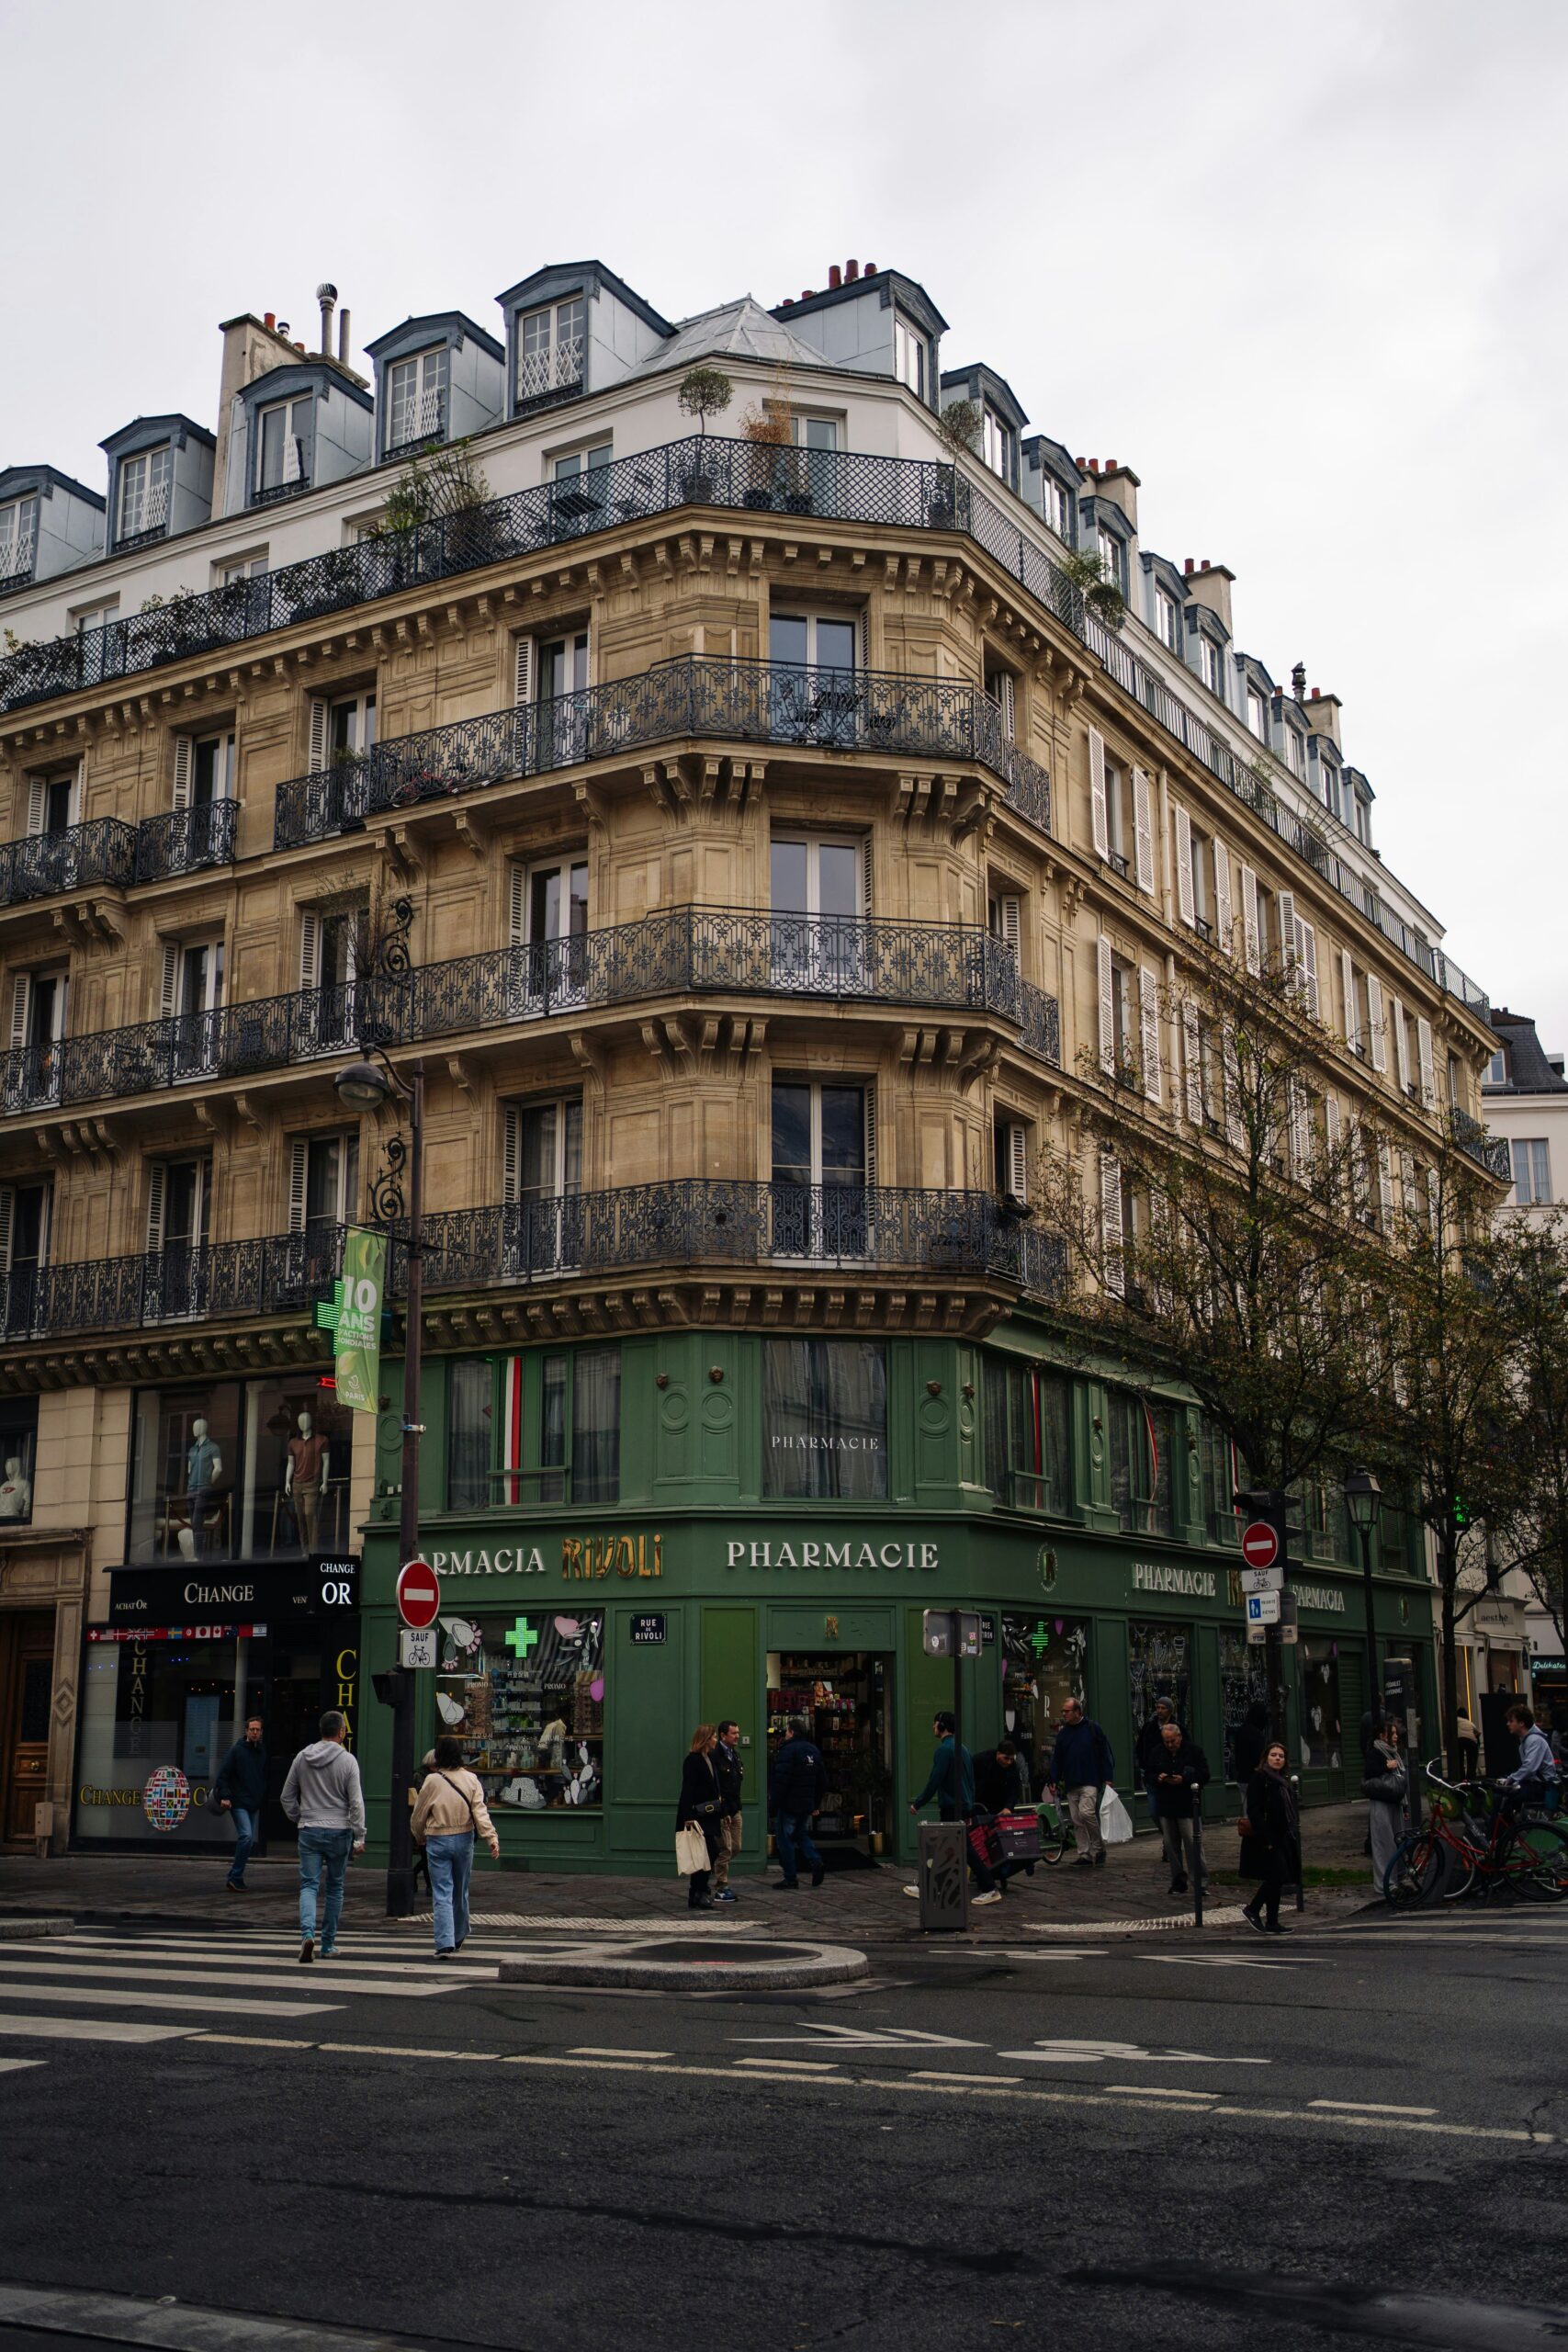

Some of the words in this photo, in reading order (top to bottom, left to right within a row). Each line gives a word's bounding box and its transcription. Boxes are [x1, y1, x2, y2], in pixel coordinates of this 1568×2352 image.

[343, 1275, 378, 1314] 10
[338, 1310, 376, 1332] ANS
[345, 1390, 366, 1402] PARIS
[772, 1436, 879, 1450] PHARMACIE
[417, 1548, 546, 1576] RMACIA
[727, 1542, 939, 1568] PHARMACIE
[320, 1562, 356, 1574] CHANGE
[1134, 1563, 1216, 1597] PHARMACIE
[321, 1581, 353, 1605] OR
[1292, 1585, 1346, 1611] FARMACIA
[640, 1619, 657, 1627] RUE
[411, 1633, 429, 1642] SAUF
[635, 1632, 662, 1640] RIVOLI
